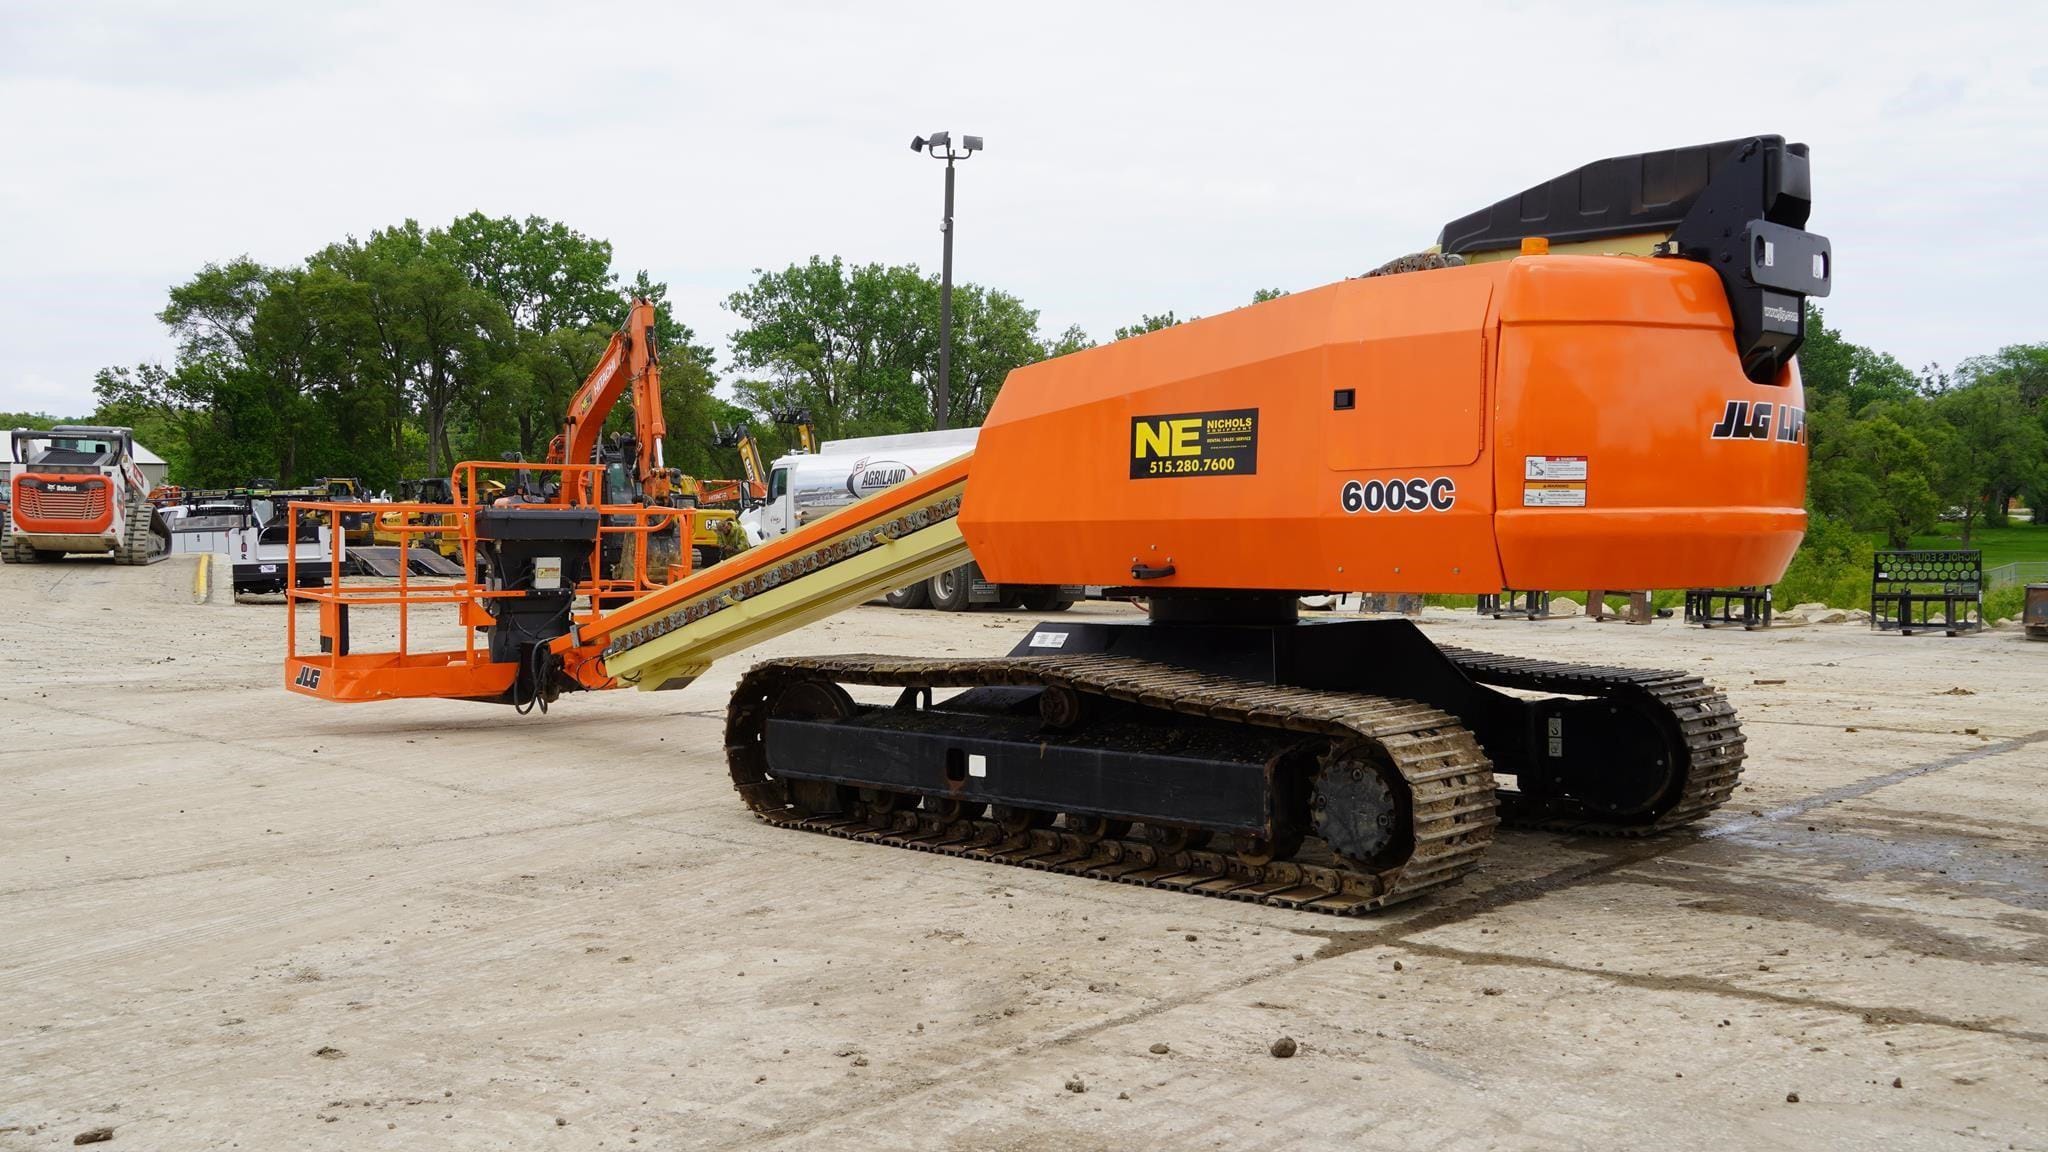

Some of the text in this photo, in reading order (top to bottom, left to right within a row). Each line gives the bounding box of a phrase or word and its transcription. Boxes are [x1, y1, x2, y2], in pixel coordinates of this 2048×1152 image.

[593, 358, 616, 396] HITACHI
[1207, 417, 1252, 429] NICHOLS
[1711, 399, 1773, 441] JLG
[1135, 418, 1202, 458] NE
[862, 469, 906, 486] AGRILAND
[1149, 457, 1235, 474] 515.280.7600
[56, 484, 77, 492] Bobcat
[1342, 476, 1455, 513] 600SC
[295, 665, 322, 691] JLG
